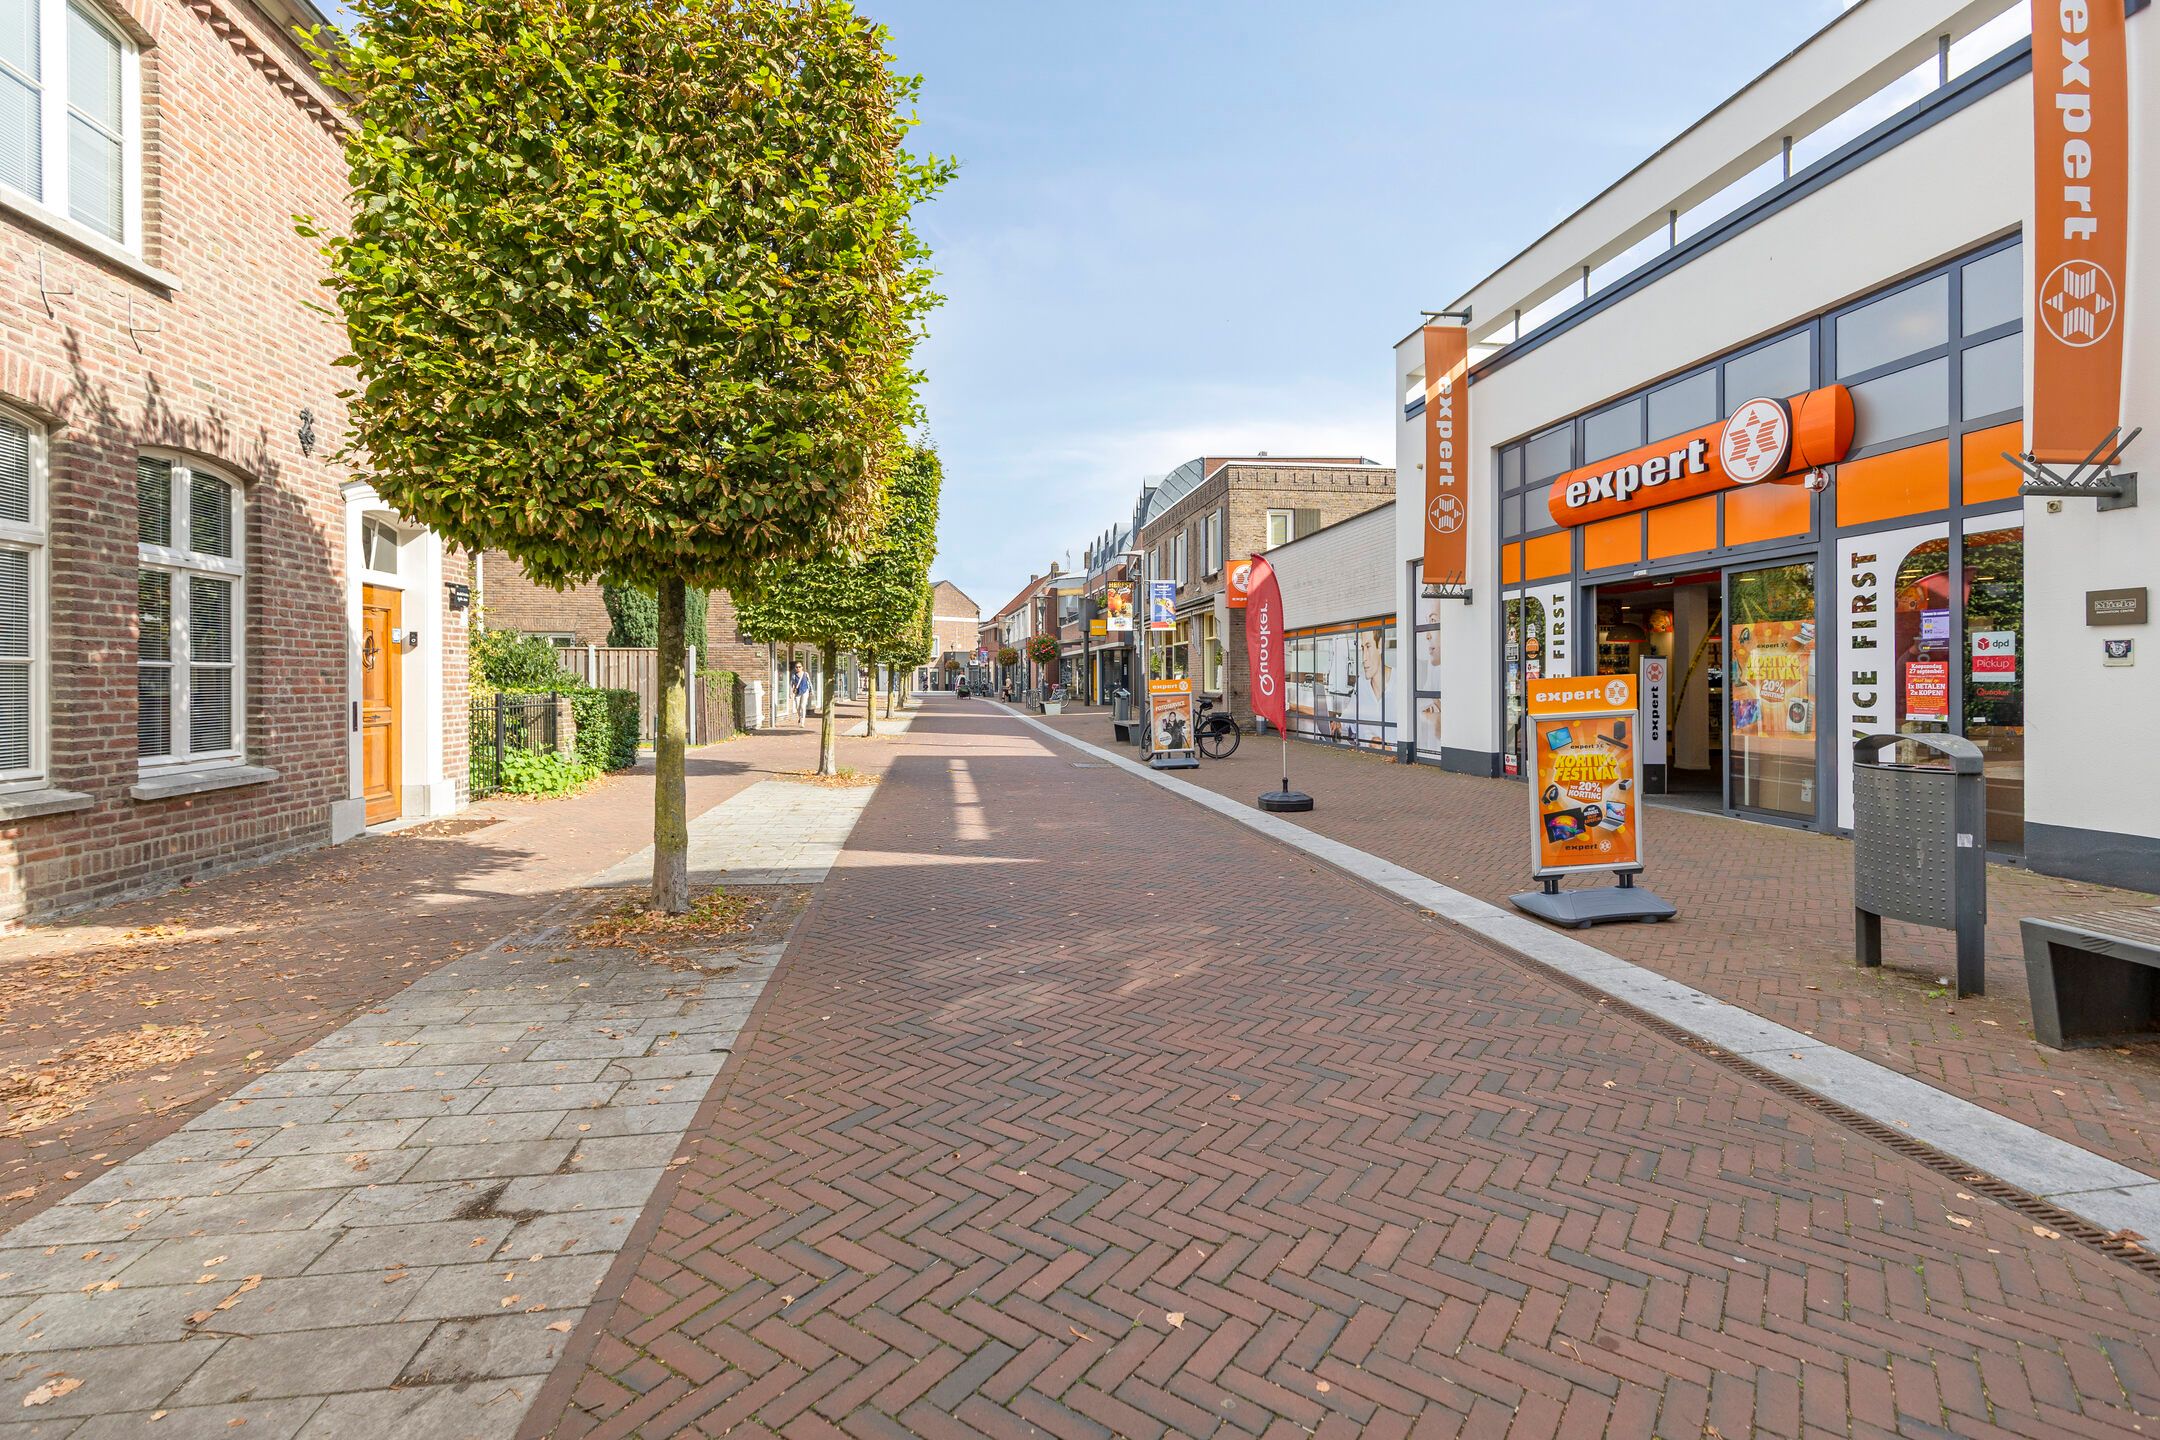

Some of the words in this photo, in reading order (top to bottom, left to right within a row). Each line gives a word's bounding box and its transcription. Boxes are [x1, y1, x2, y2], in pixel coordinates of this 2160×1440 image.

[2055, 0, 2097, 240] expert
[1436, 376, 1455, 487] expert
[1566, 439, 1707, 508] expert
[1852, 552, 1877, 649] FIRST
[1553, 594, 1565, 659] FIRST
[1259, 602, 1275, 696] Quooker
[1992, 640, 2009, 649] dpd
[1976, 659, 2010, 670] Pickup
[1762, 680, 1784, 693] 20%
[1535, 688, 1601, 703] expert
[1651, 686, 1660, 741] expert
[1555, 753, 1618, 768] KORTING
[1553, 766, 1619, 782] FESTIVAL
[1568, 789, 1601, 800] KORTING
[1579, 781, 1601, 793] 20%
[1564, 843, 1598, 851] expert
